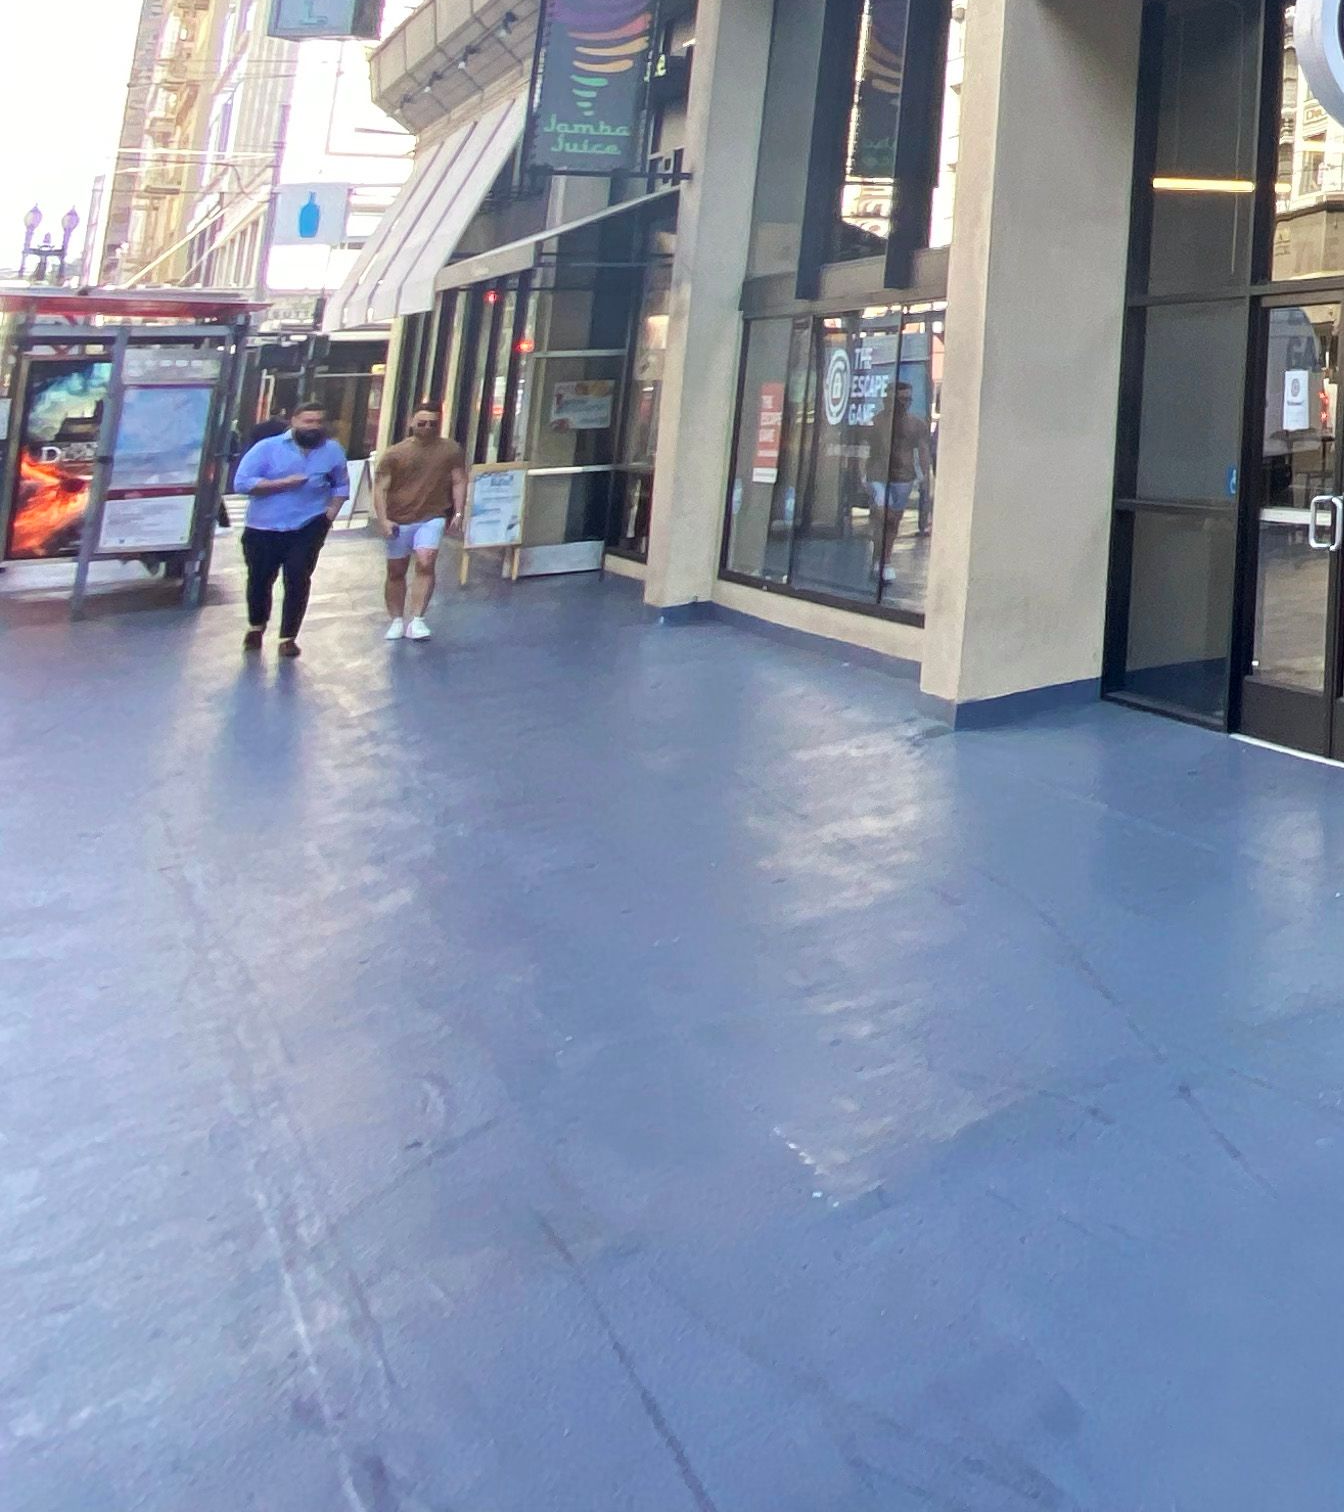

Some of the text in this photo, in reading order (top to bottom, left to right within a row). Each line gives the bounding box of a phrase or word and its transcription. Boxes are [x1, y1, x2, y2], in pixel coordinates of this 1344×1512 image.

[543, 113, 631, 136] Jamba
[550, 134, 622, 156] Juice
[854, 347, 873, 370] THE
[850, 375, 889, 399] ESCAPE
